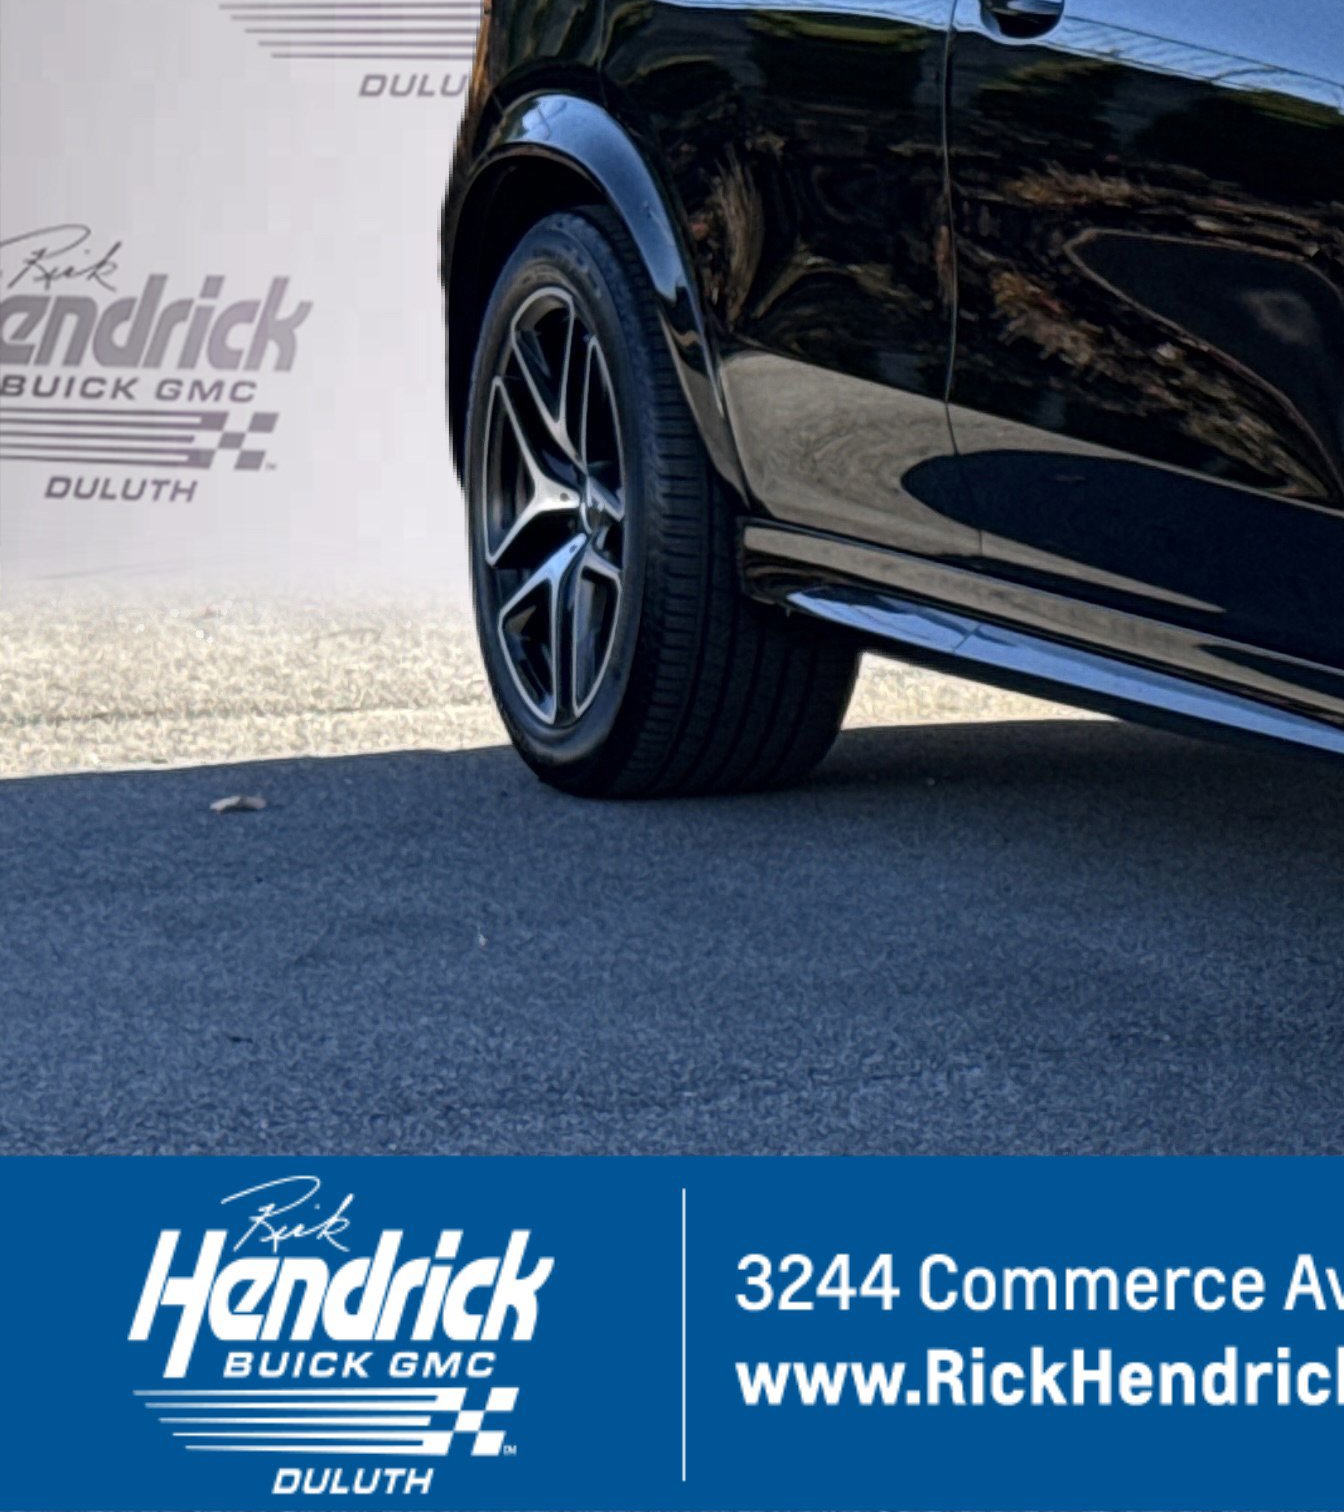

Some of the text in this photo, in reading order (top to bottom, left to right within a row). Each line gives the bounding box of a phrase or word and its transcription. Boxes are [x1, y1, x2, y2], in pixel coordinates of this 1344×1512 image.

[359, 74, 467, 98] DULU
[0, 273, 313, 372] endrick
[0, 374, 256, 403] BUICK GMC
[45, 476, 197, 502] DULUTH
